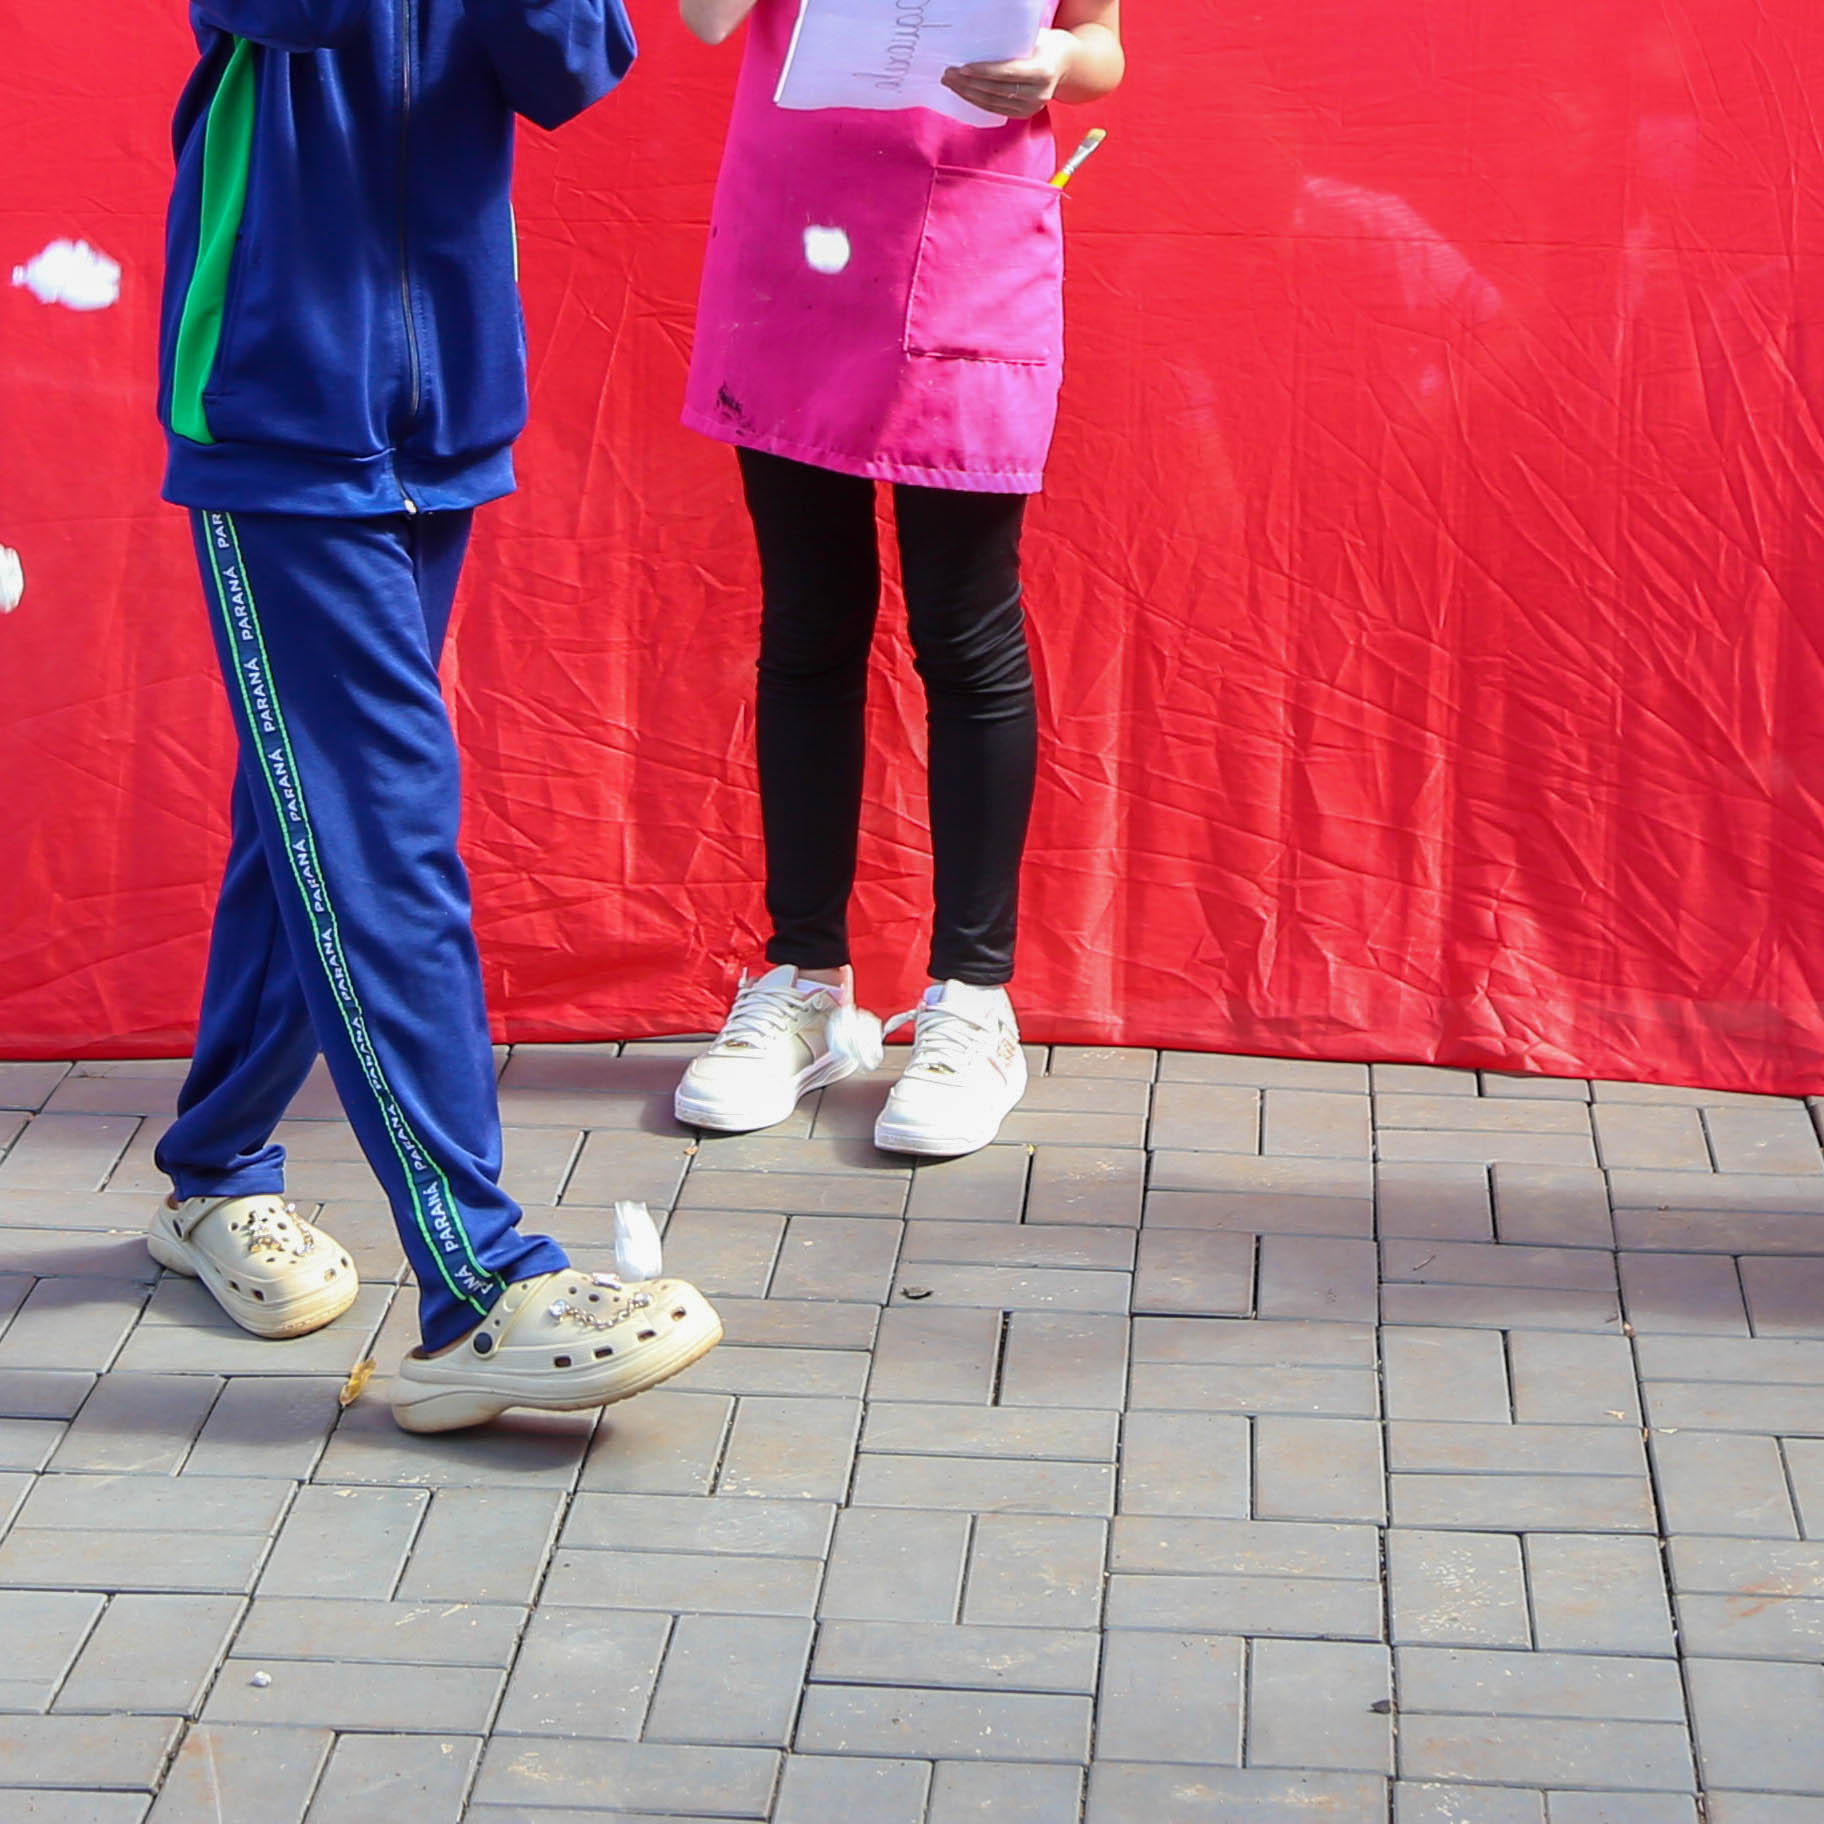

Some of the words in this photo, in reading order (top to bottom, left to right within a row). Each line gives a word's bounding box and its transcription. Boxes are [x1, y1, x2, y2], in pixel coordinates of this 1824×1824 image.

[226, 566, 254, 640] PARANÁ
[243, 657, 276, 732] PARANÁ
[267, 748, 302, 822] PARANÁ
